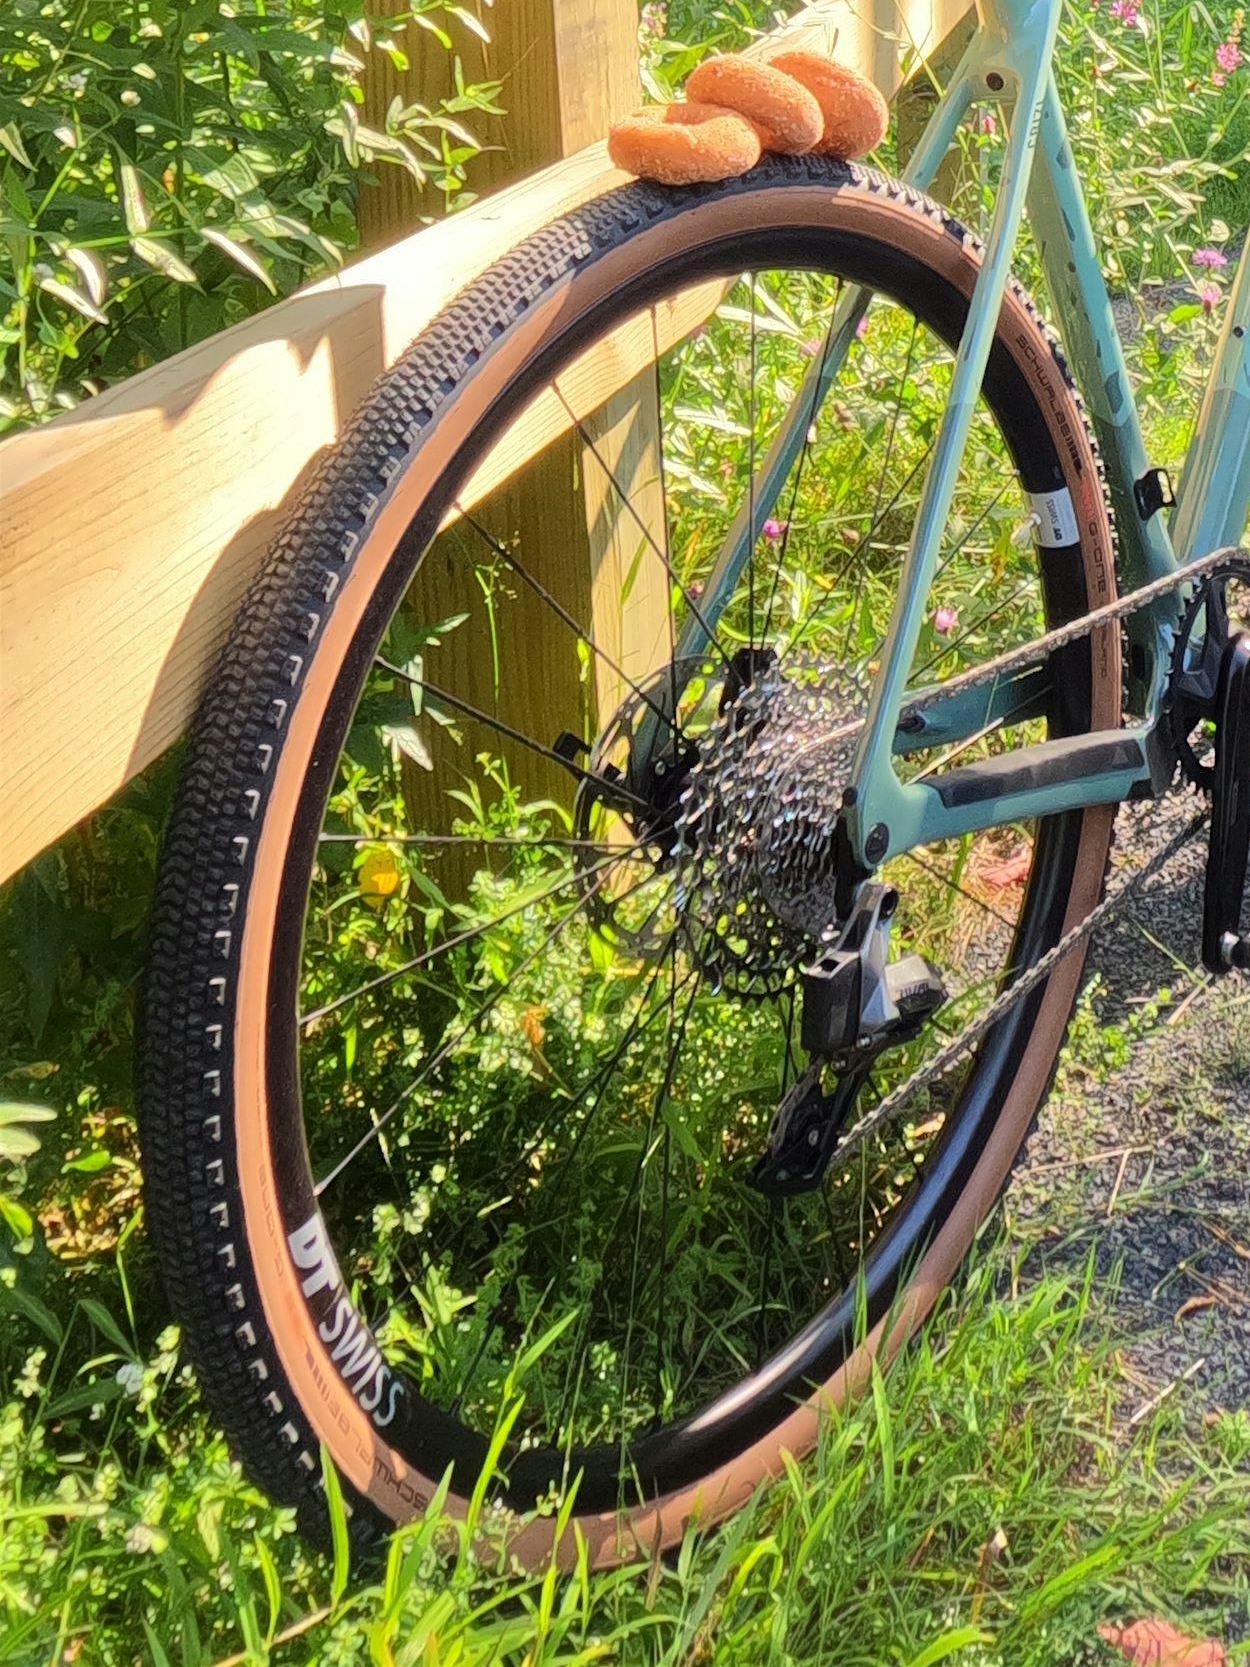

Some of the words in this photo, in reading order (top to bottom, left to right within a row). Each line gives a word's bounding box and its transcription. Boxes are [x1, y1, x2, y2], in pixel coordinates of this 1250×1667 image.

[1016, 334, 1071, 437] SCHWALBE
[1088, 522, 1107, 593] G-ONE
[288, 1213, 341, 1298] DT
[318, 1296, 405, 1427] SWISS
